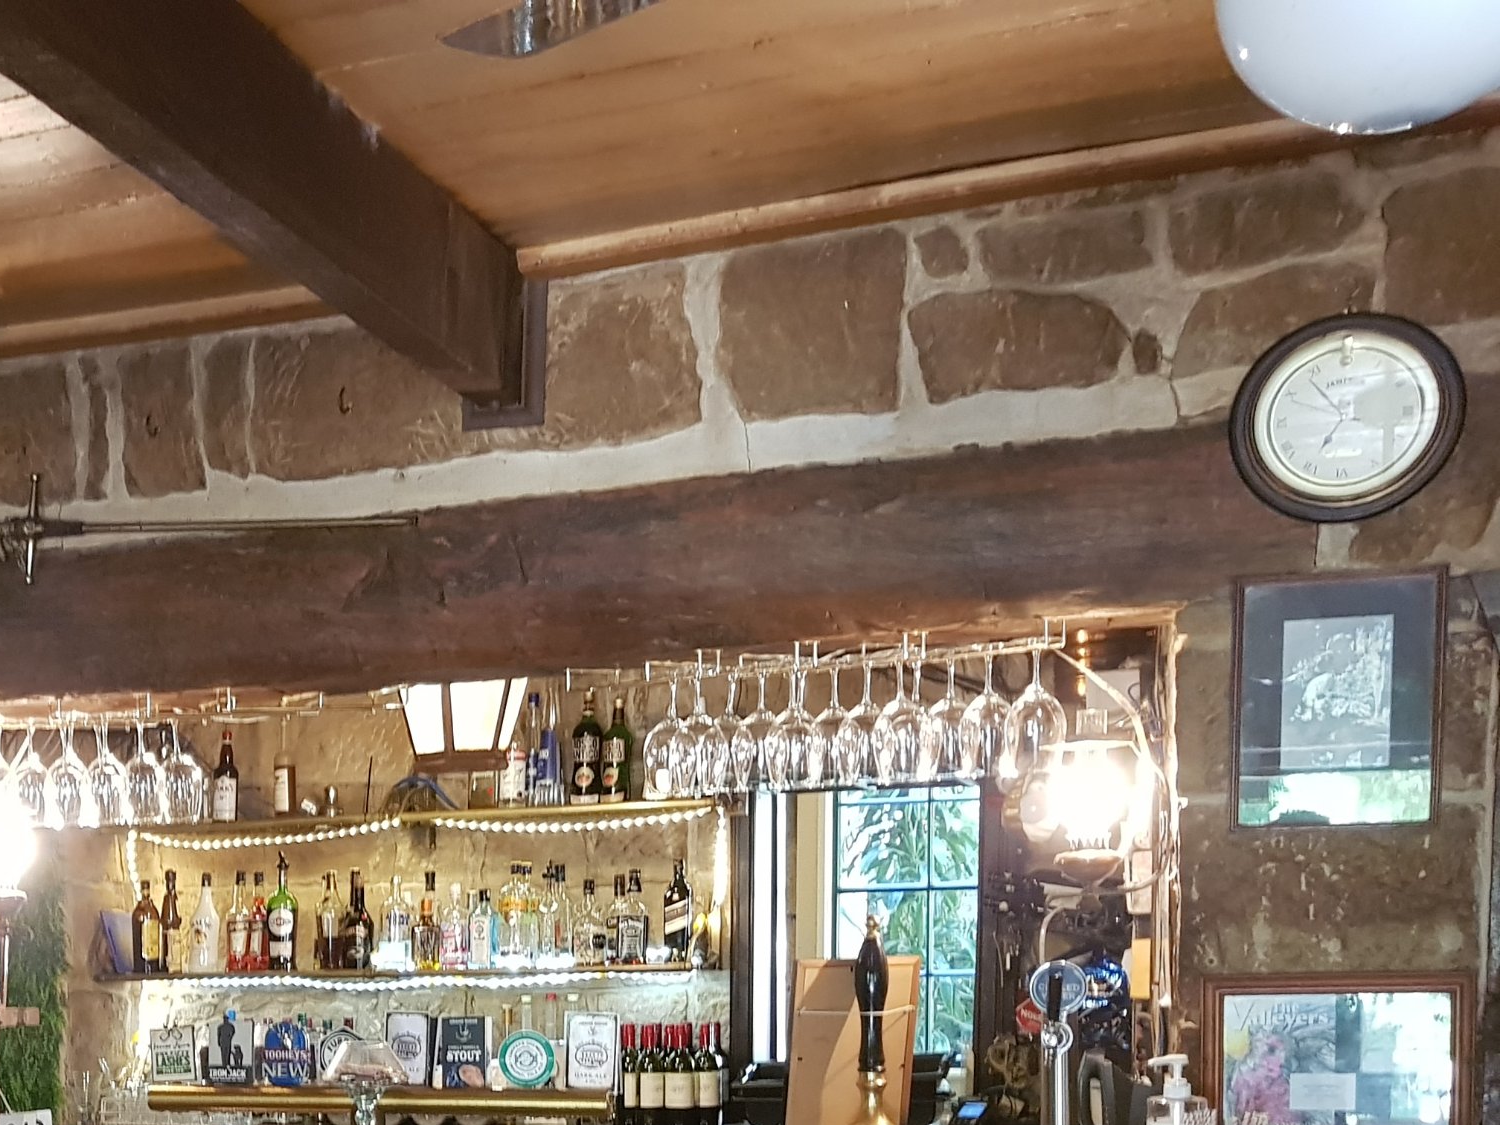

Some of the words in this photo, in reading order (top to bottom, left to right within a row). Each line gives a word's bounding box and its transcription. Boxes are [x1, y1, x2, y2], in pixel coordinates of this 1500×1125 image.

[446, 1050, 482, 1063] STOUT
[228, 1065, 247, 1078] JACK
[262, 1062, 309, 1077] NEW
